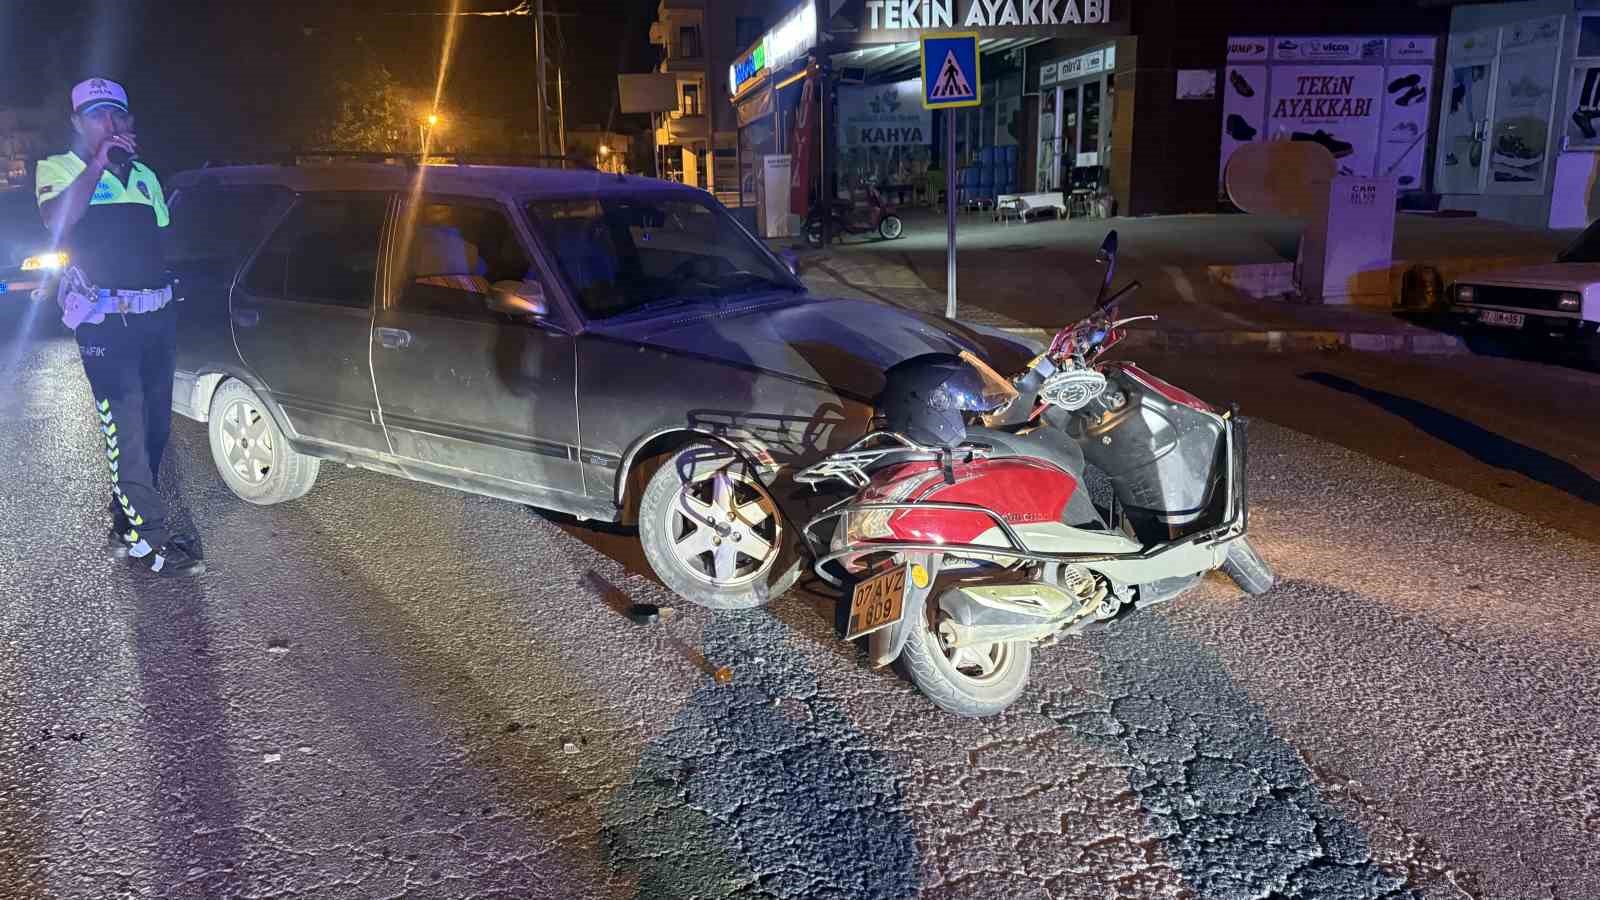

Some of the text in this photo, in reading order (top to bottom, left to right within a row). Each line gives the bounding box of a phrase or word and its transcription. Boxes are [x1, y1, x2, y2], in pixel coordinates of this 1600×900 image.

[964, 0, 1111, 27] AYAKKABI
[1272, 99, 1373, 117] AYAKKABI
[861, 127, 923, 142] KAHYA
[856, 573, 903, 607] 07 AVZ
